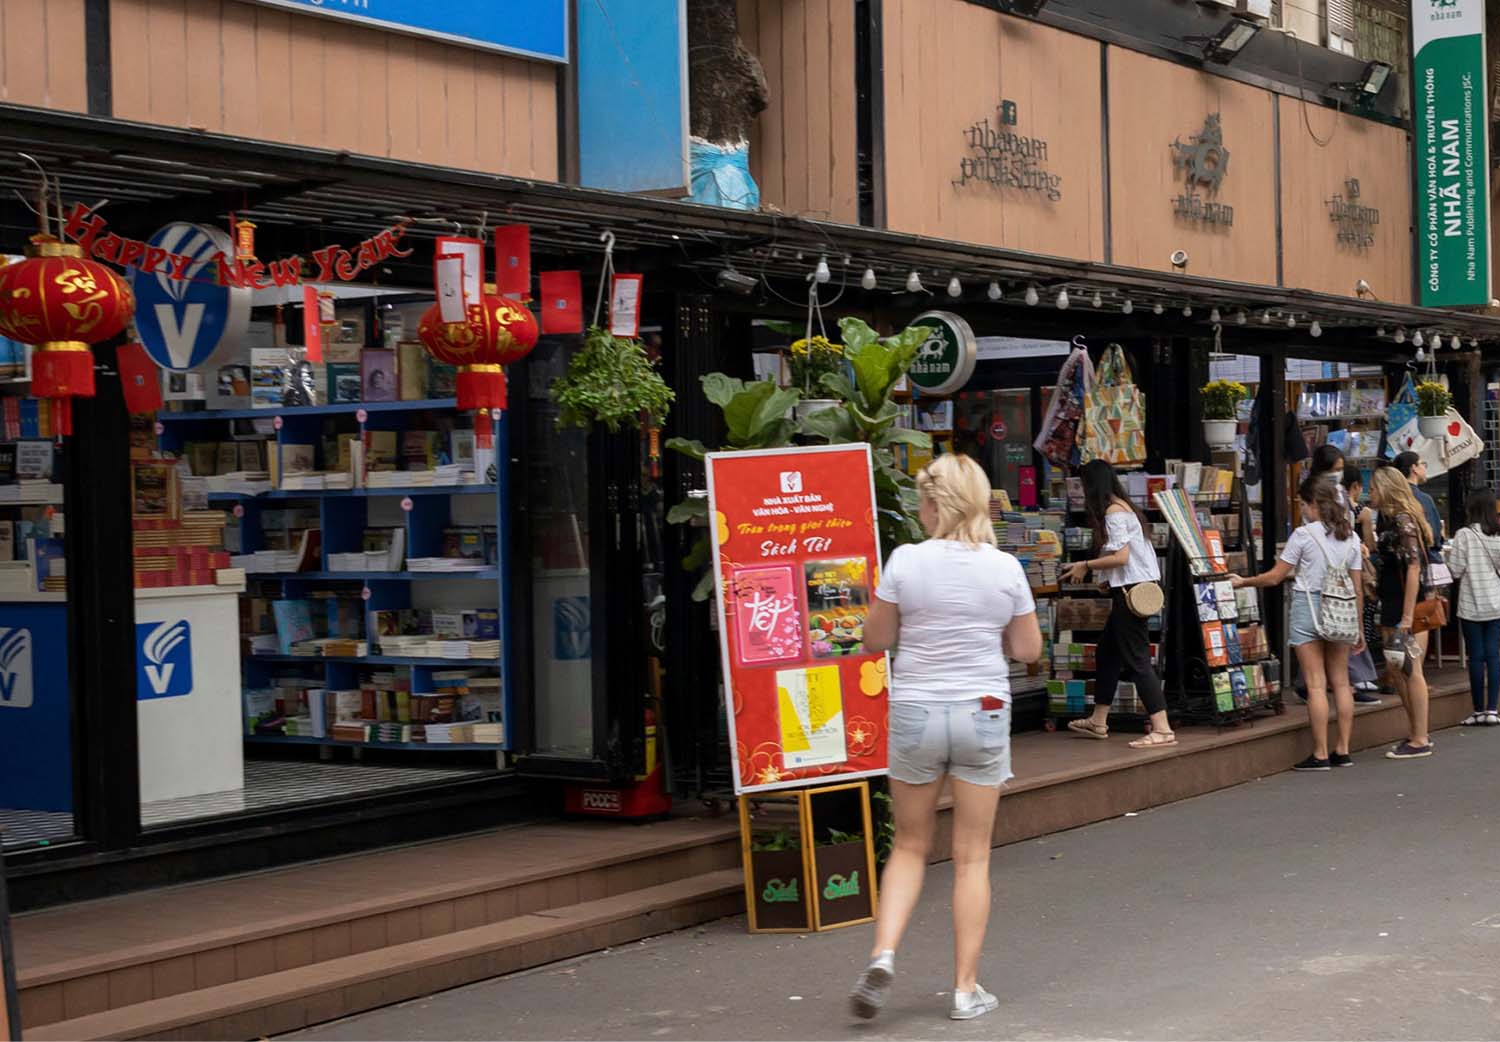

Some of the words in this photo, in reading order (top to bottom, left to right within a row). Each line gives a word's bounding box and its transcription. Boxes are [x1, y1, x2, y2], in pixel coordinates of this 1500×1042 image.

[1425, 68, 1435, 104] THÔNG
[1425, 105, 1436, 144] TRUYỀN
[1464, 90, 1474, 167] Communications
[1441, 120, 1461, 177] NAM
[1427, 180, 1436, 201] VĂN
[1464, 170, 1474, 187] and
[1427, 203, 1437, 230] PHẦN
[1439, 183, 1462, 237] NHÃ
[1465, 188, 1476, 236] Publishing
[1430, 249, 1438, 261] TY
[1466, 238, 1475, 260] Nam
[1428, 263, 1439, 292] CÔNG
[1466, 262, 1476, 280] Nha
[153, 303, 206, 369] V
[752, 506, 771, 517] VĂN
[795, 504, 812, 515] VĂN
[812, 502, 834, 514] NGHỆ
[763, 495, 782, 506] NHÀ
[782, 493, 804, 505] XUẤT
[804, 492, 822, 503] BẢN
[760, 538, 798, 557] Sách
[802, 535, 833, 553] Tết
